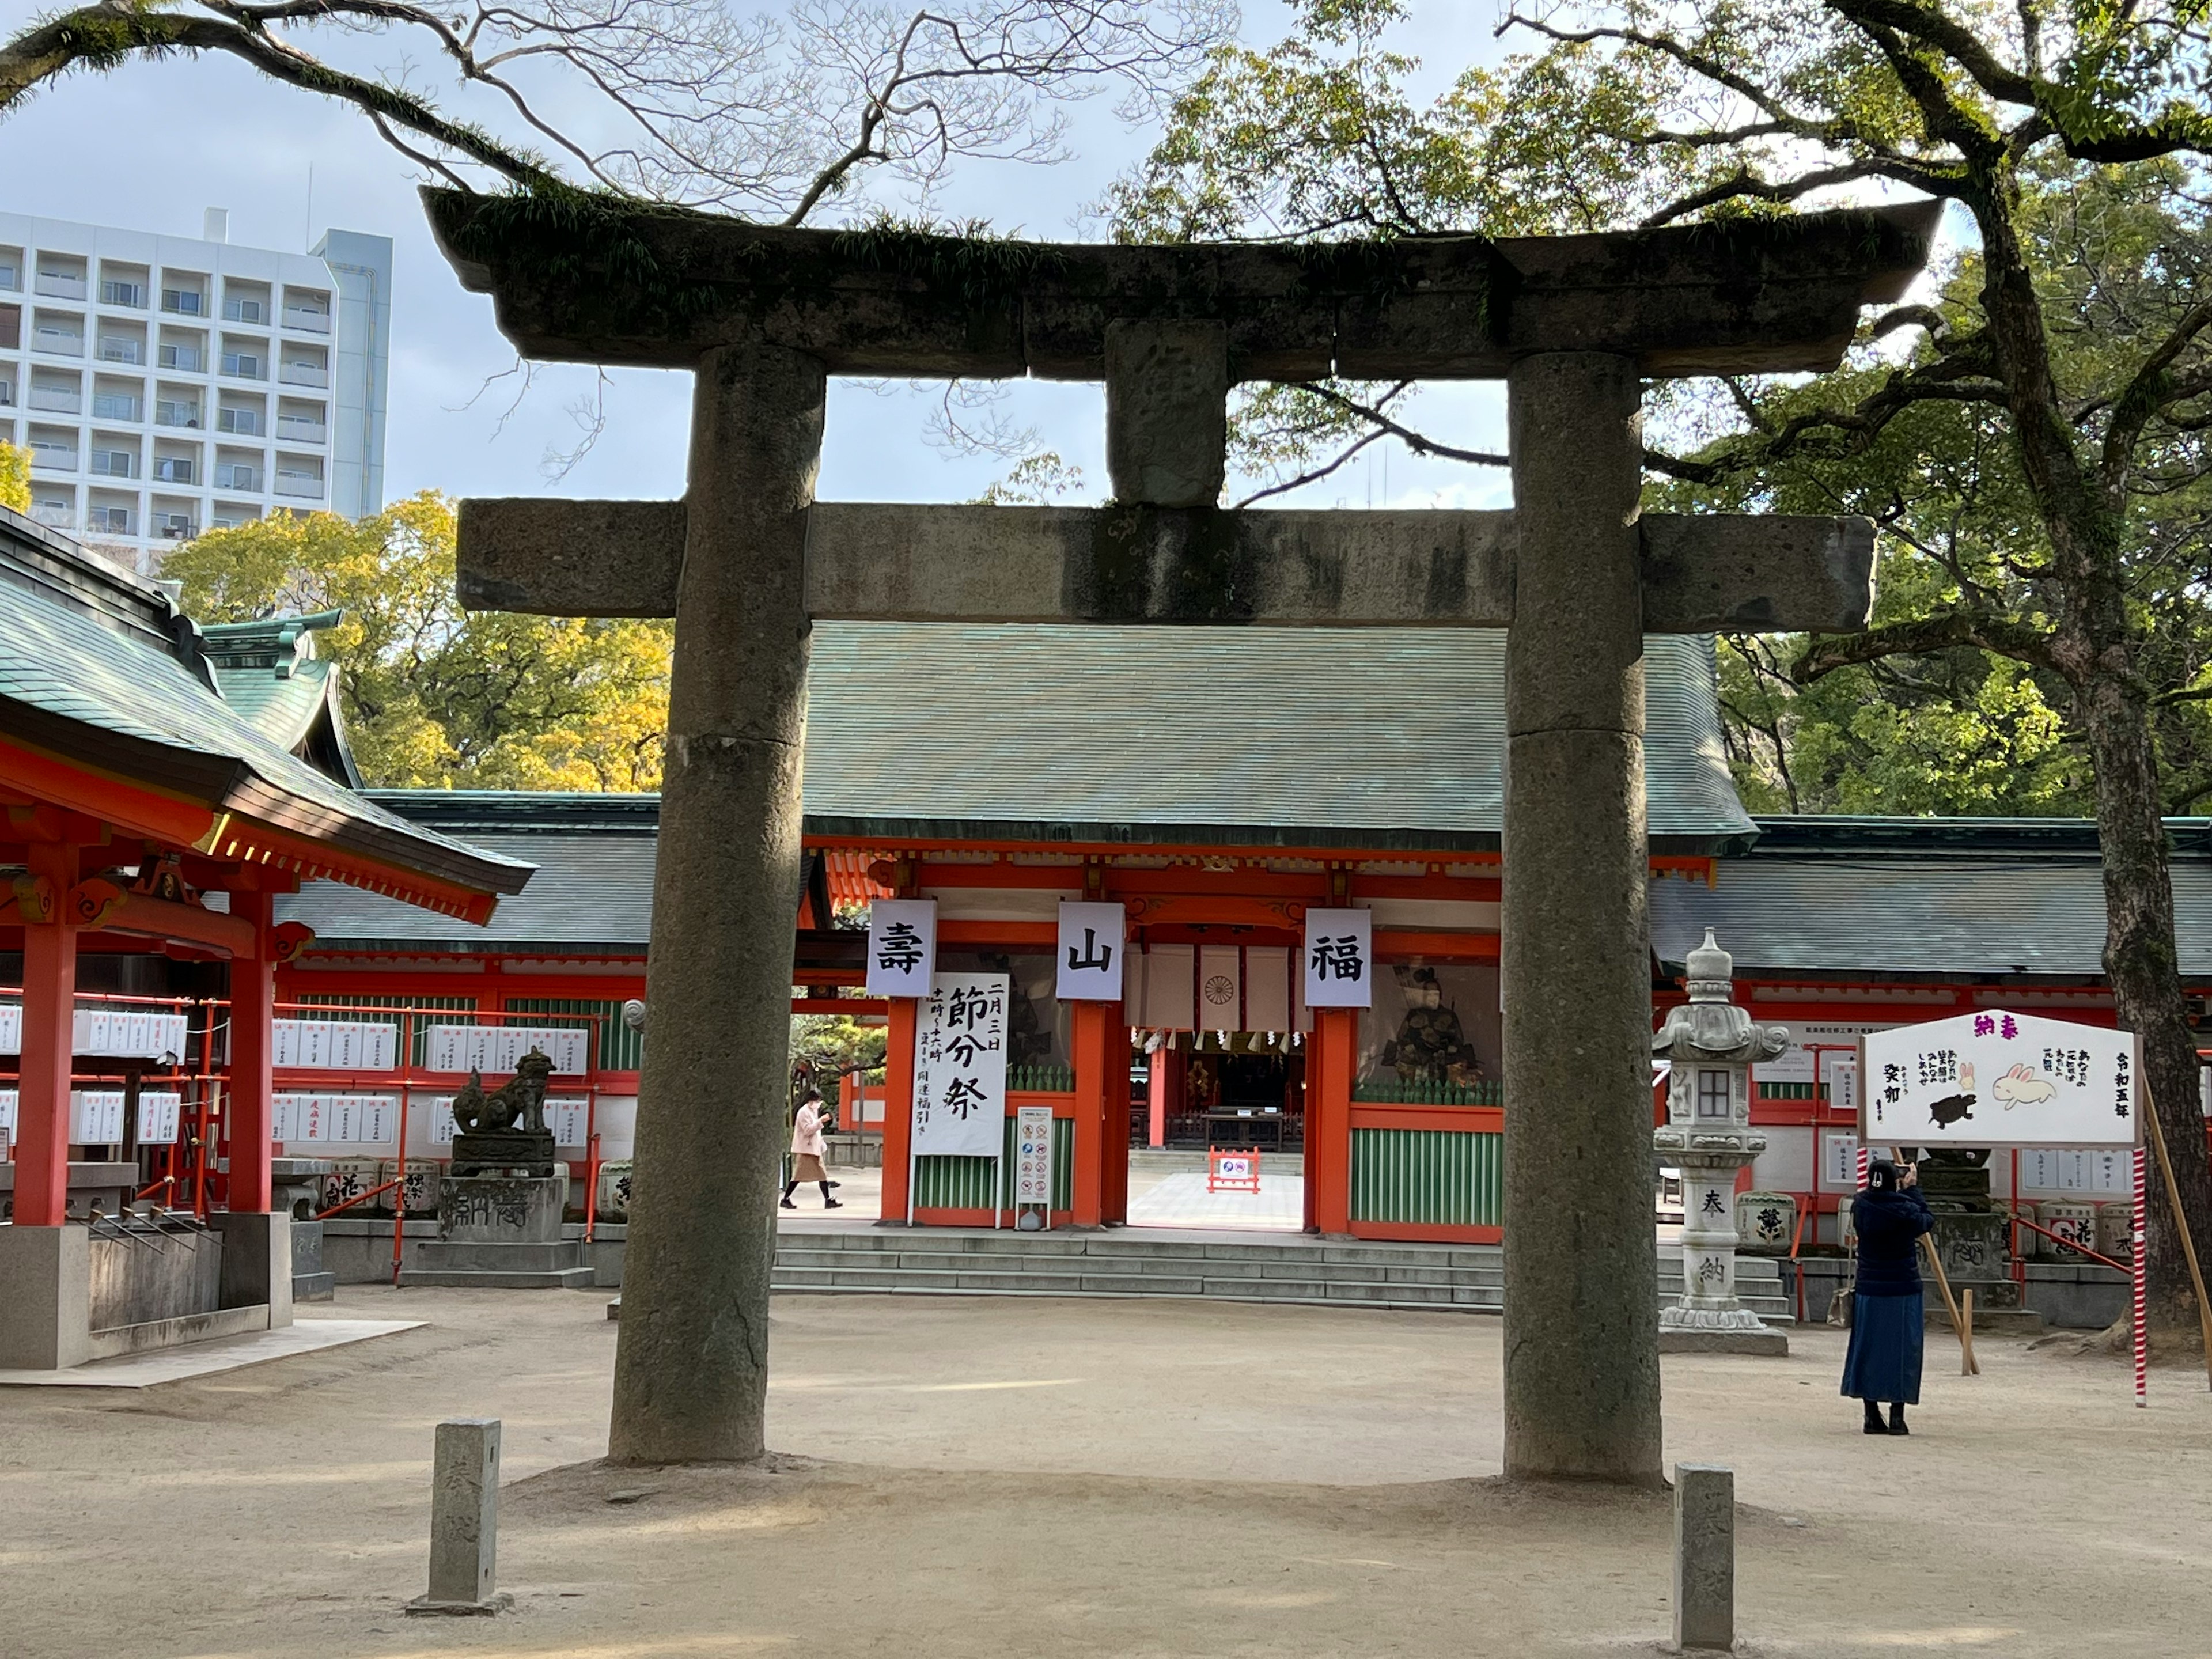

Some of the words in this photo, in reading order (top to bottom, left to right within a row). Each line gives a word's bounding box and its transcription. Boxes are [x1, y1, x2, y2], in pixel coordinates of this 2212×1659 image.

[876, 922, 924, 975] 壽
[1068, 928, 1112, 972] 山
[1311, 935, 1364, 982] 福
[987, 984, 1005, 1051] 二月三日
[942, 986, 988, 1120] 節分祭
[2115, 1052, 2130, 1118] 令和五年
